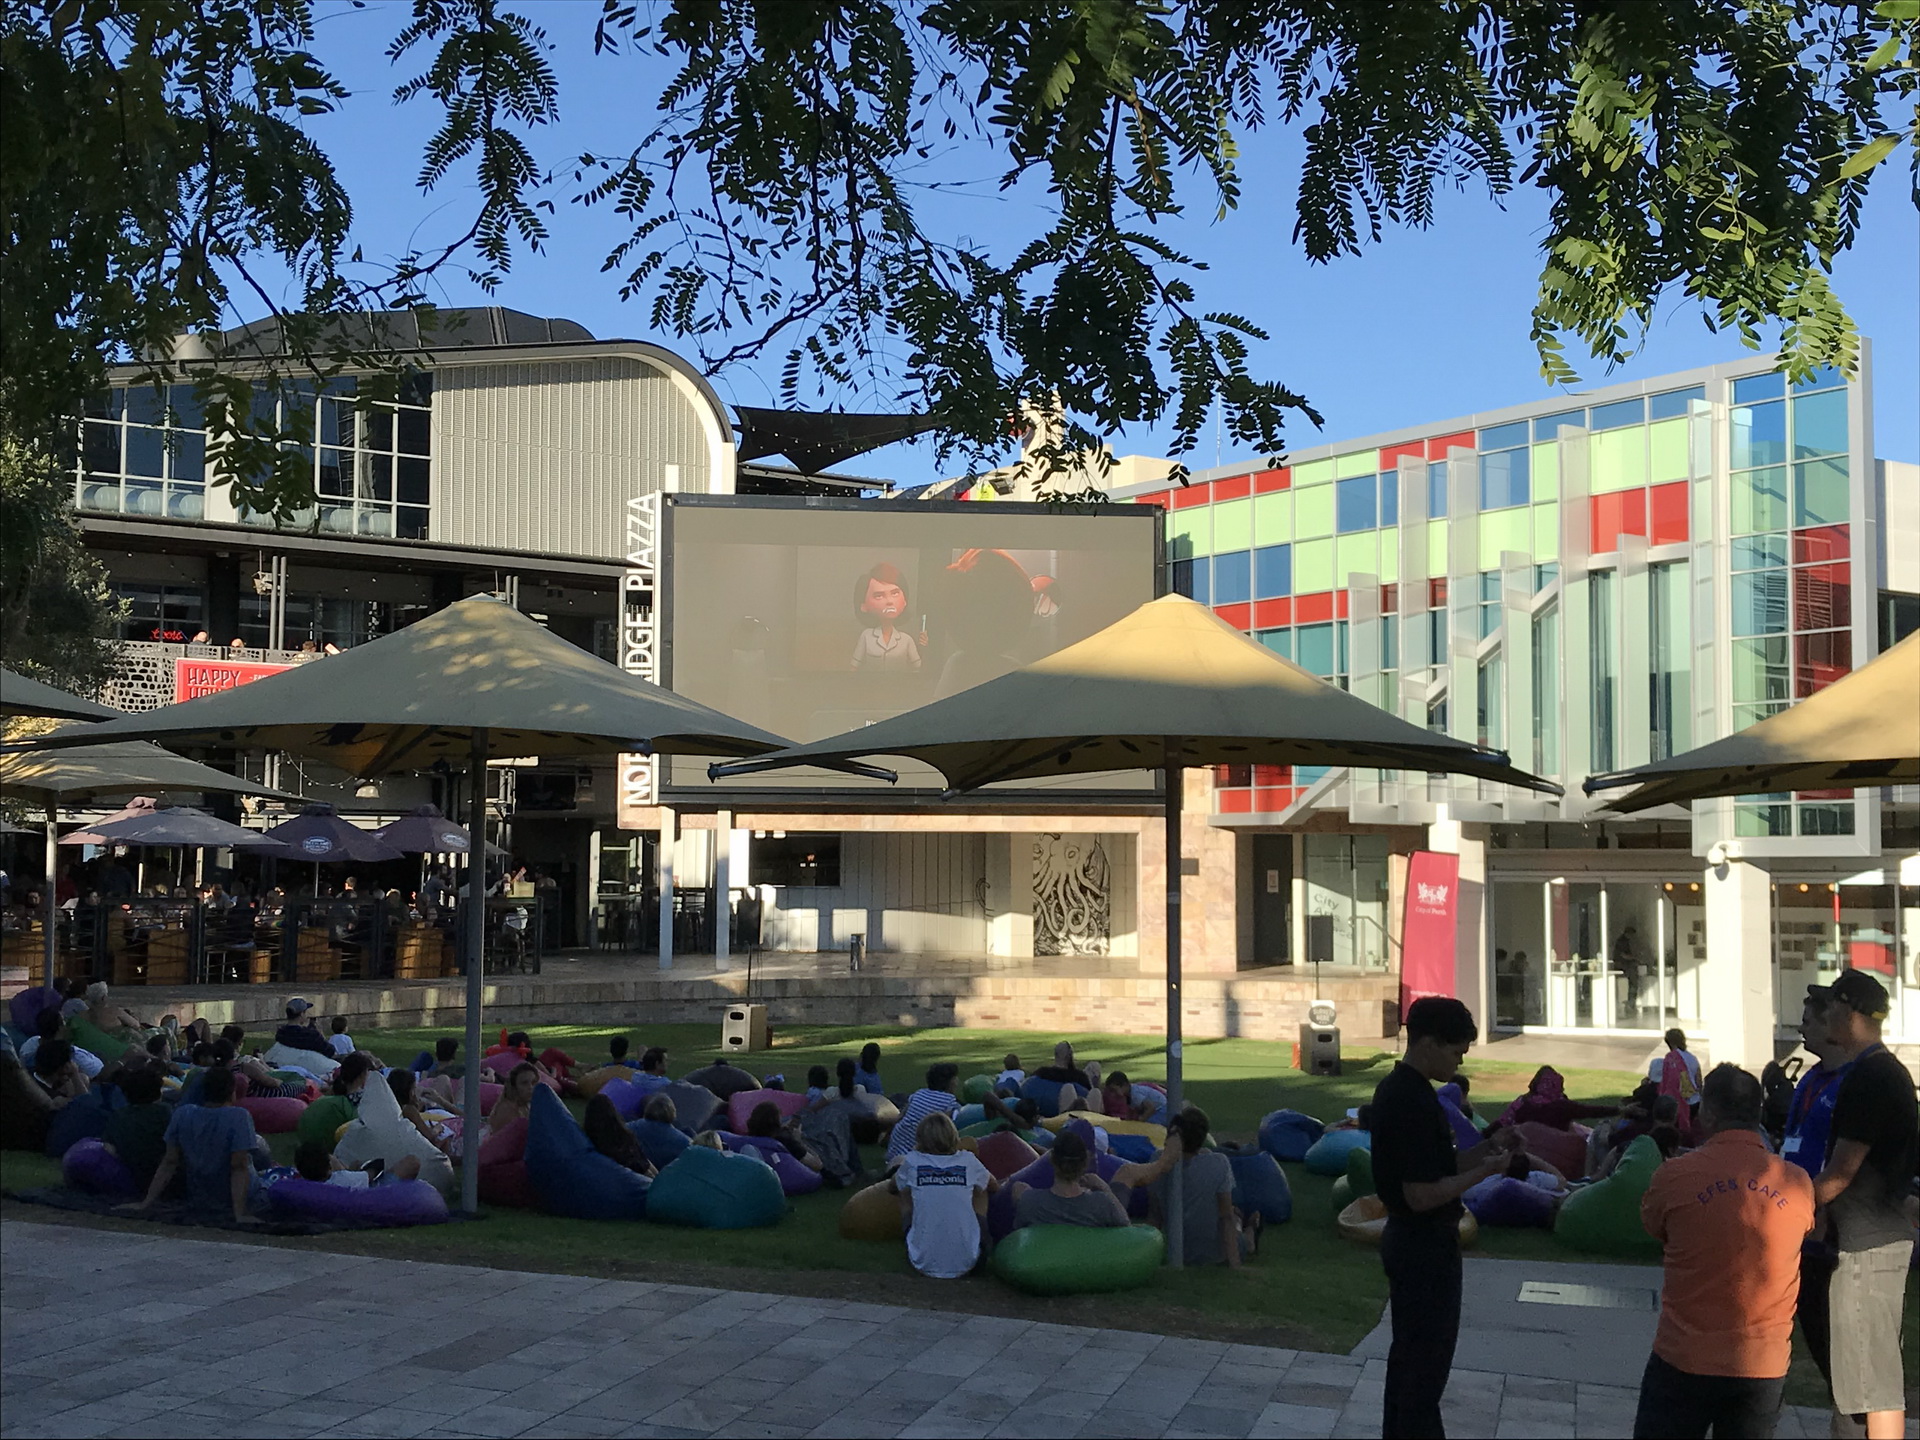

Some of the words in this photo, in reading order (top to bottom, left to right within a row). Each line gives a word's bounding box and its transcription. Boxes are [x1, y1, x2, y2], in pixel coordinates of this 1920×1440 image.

[626, 493, 656, 591] PIAZZA
[187, 667, 241, 687] HAPPY
[623, 612, 654, 805] NOIDGE
[1314, 893, 1340, 910] City
[918, 1175, 965, 1185] patagonia
[1696, 1178, 1738, 1205] EFES
[1747, 1178, 1789, 1210] CAFE
